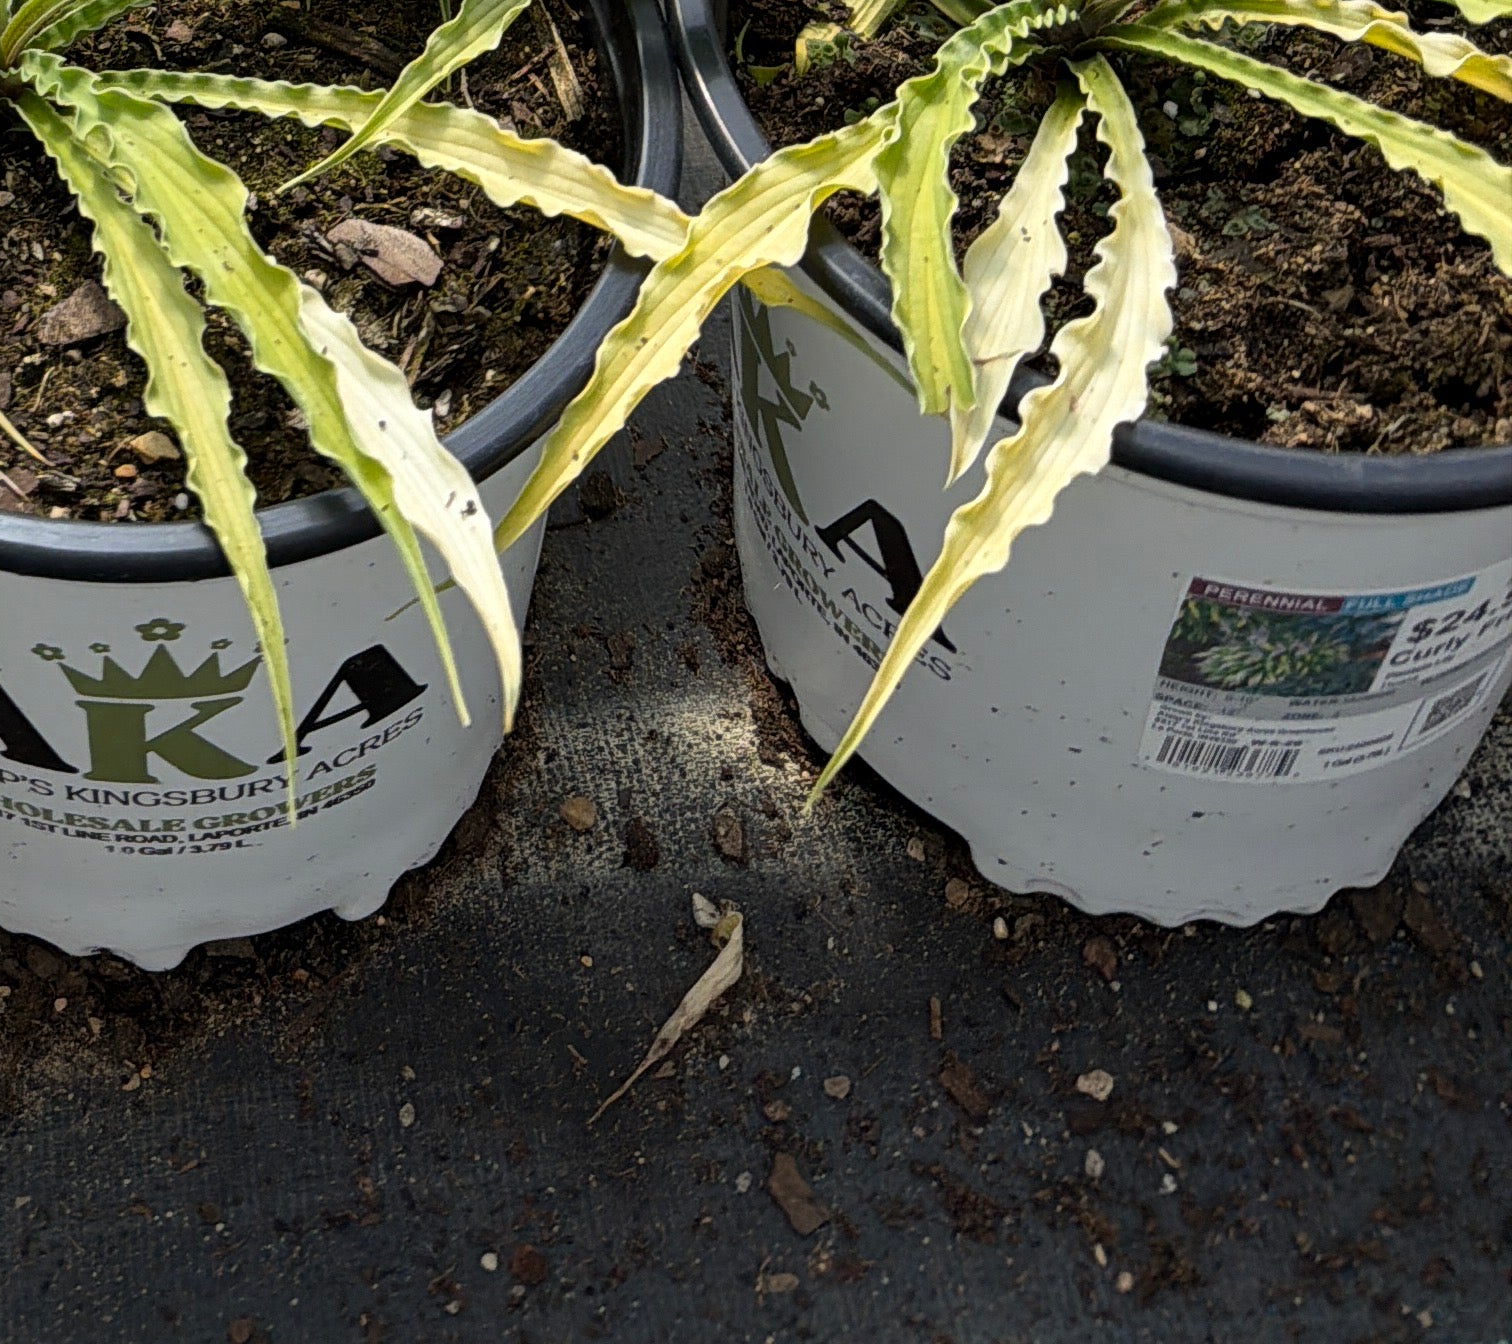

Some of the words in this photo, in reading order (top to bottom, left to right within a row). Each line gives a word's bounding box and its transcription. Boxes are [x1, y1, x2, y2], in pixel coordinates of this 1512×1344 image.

[1203, 585, 1328, 612] PERENNIAL
[1390, 631, 1471, 666] Curly
[65, 767, 301, 809] KINGSBURY
[305, 705, 424, 781] ACRES
[23, 817, 62, 834] 1ST
[62, 827, 111, 843] LINE
[295, 805, 319, 821] IN
[320, 778, 377, 810] 46350
[193, 764, 377, 830] GROWERS
[139, 846, 173, 856] Gal
[189, 841, 233, 854] 3.79
